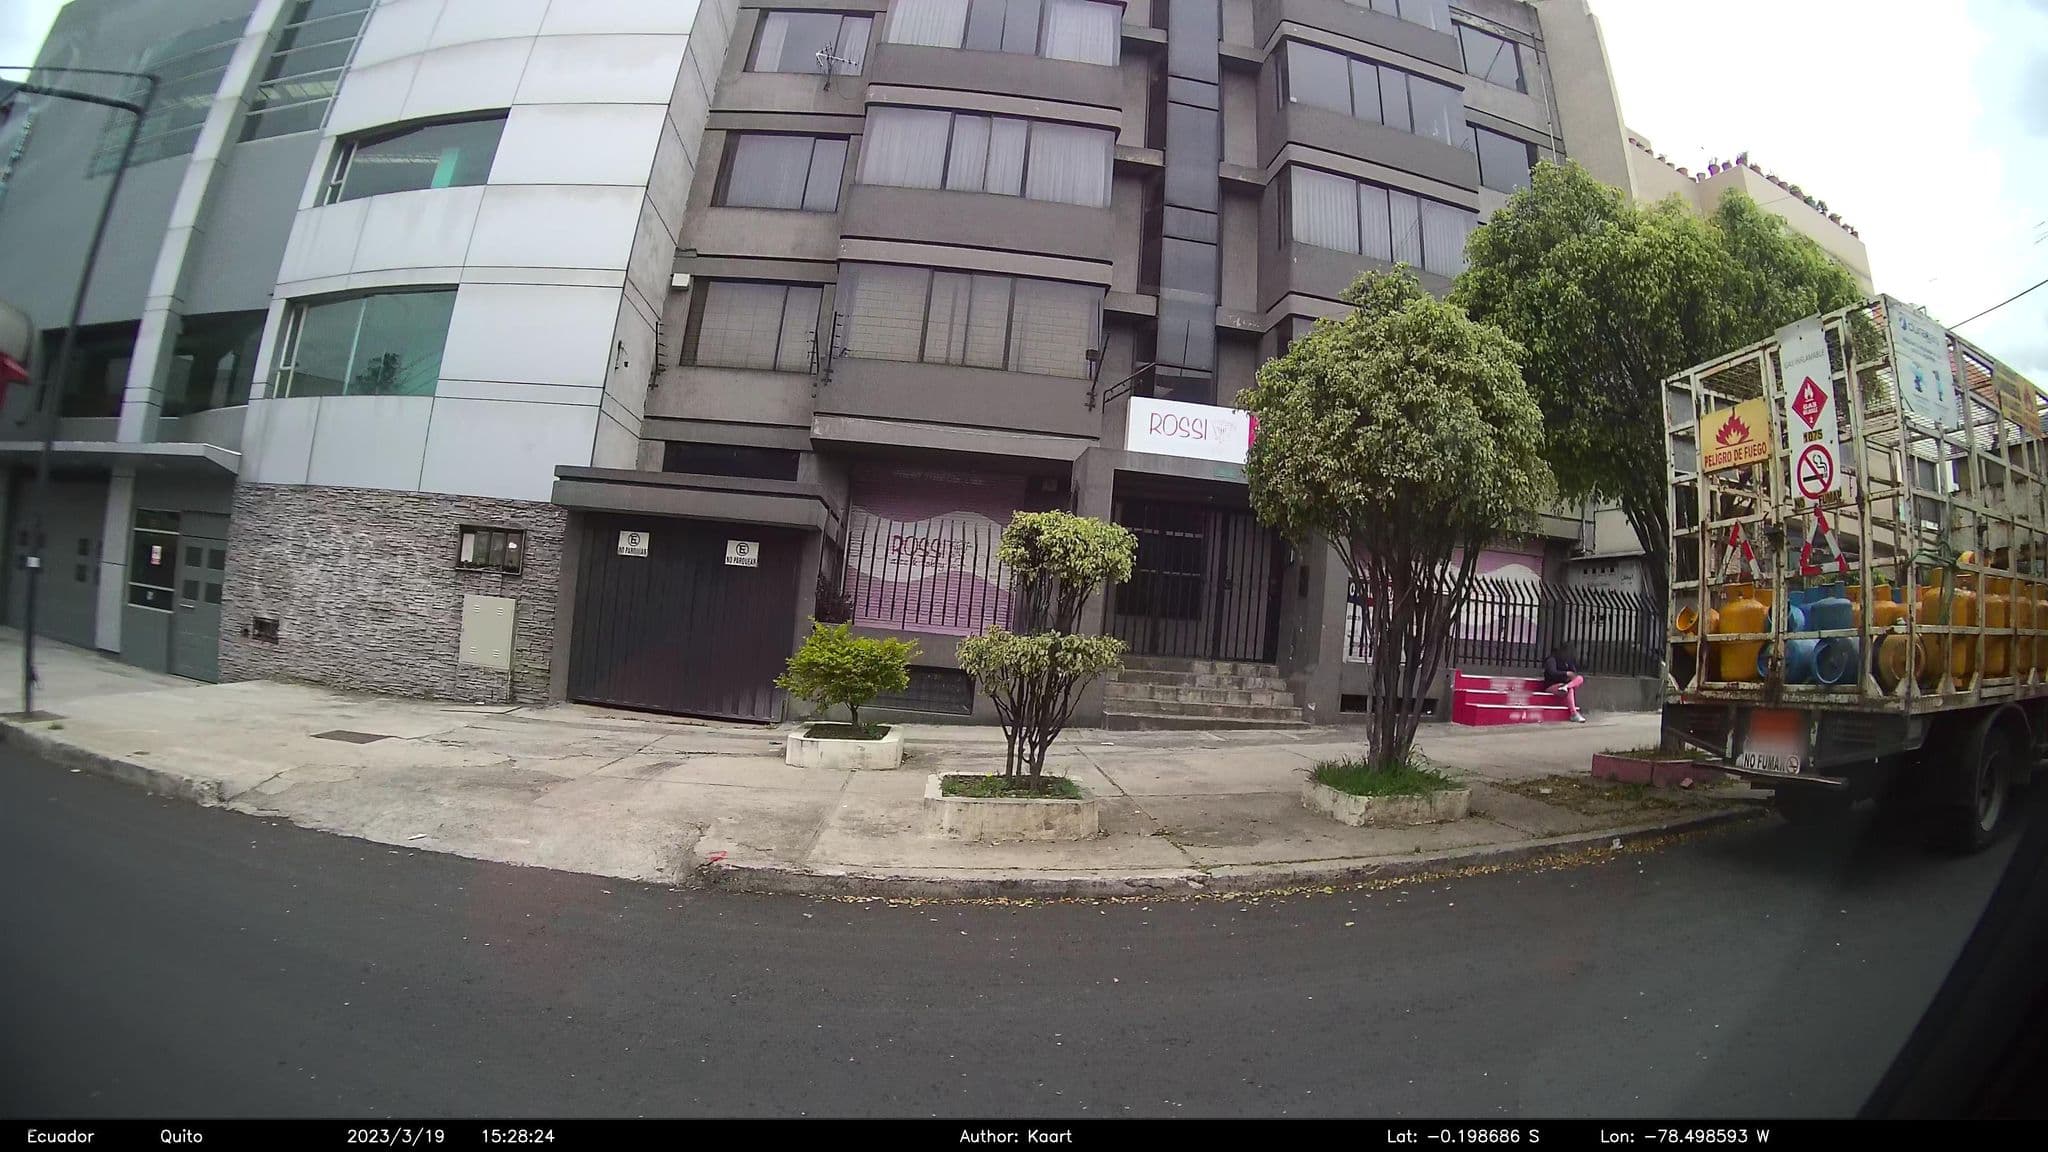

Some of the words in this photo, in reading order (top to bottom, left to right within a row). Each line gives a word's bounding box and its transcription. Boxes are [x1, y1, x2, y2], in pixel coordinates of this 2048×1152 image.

[1149, 412, 1208, 440] ROSSI
[1803, 429, 1823, 443] 1075
[1704, 451, 1733, 468] PELIGRO
[1733, 447, 1744, 462] DE
[1744, 442, 1768, 459] FUEGO
[892, 535, 947, 559] ROSSI
[726, 556, 733, 564] NO
[1744, 752, 1756, 768] NO
